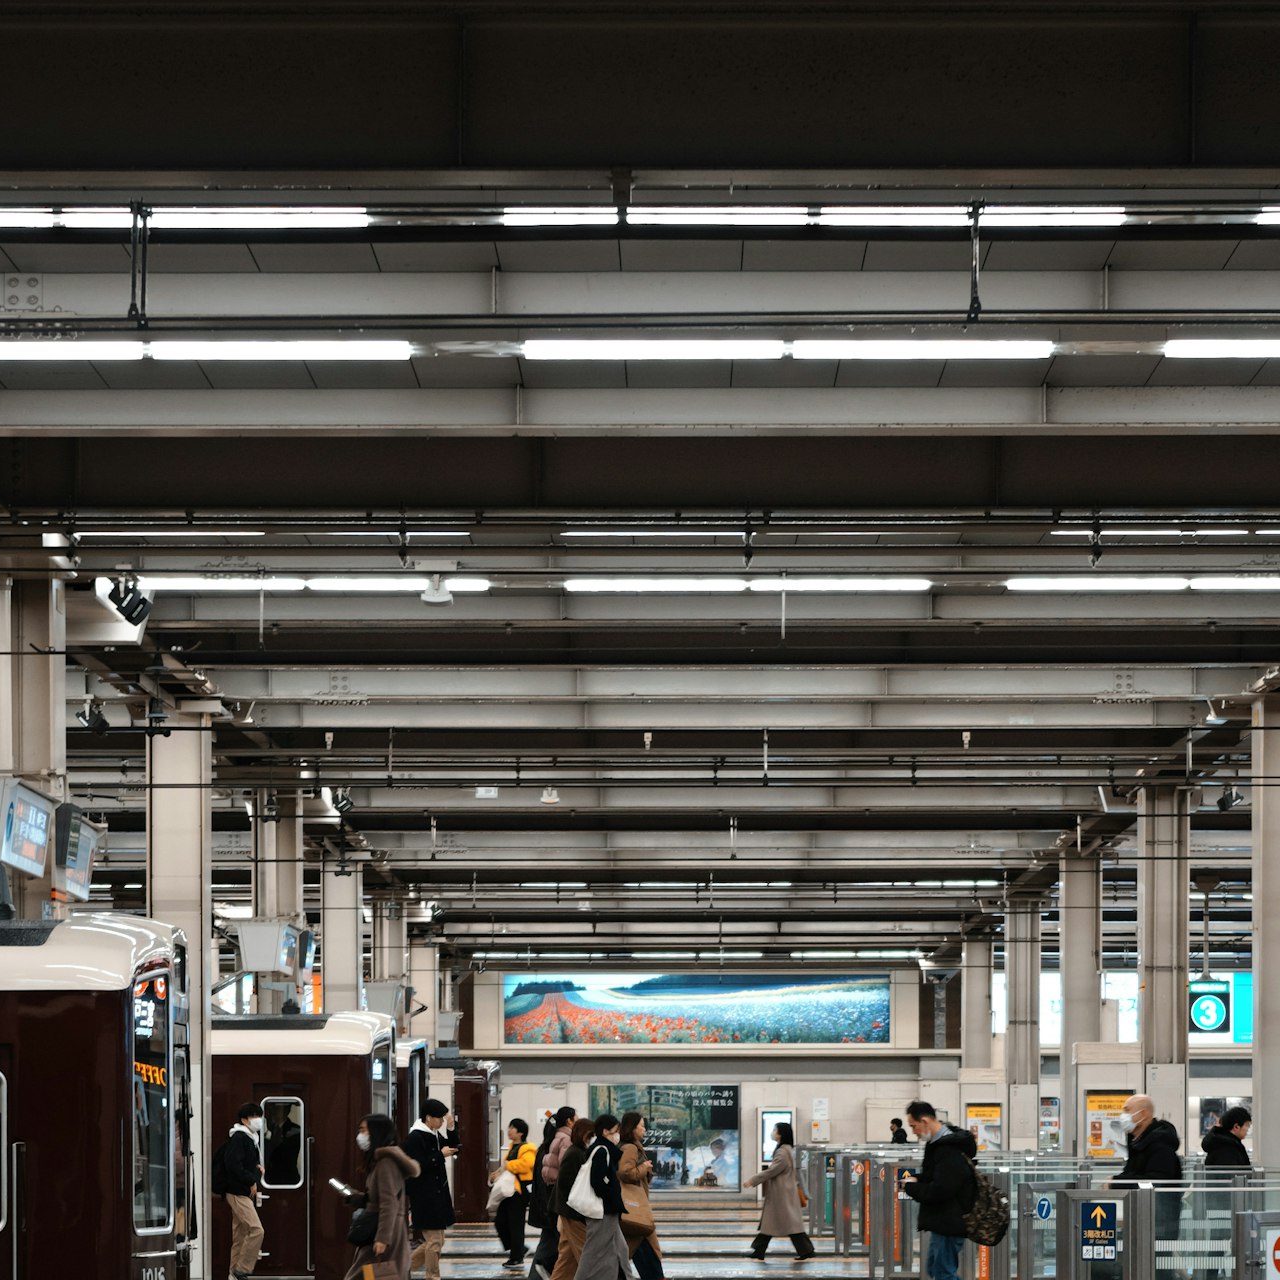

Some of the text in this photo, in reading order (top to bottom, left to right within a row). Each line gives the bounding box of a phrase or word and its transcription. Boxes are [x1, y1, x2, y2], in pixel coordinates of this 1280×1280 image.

[1199, 1001, 1217, 1026] 3
[1040, 1201, 1048, 1217] 7
[1083, 1230, 1114, 1238] 3階改札口
